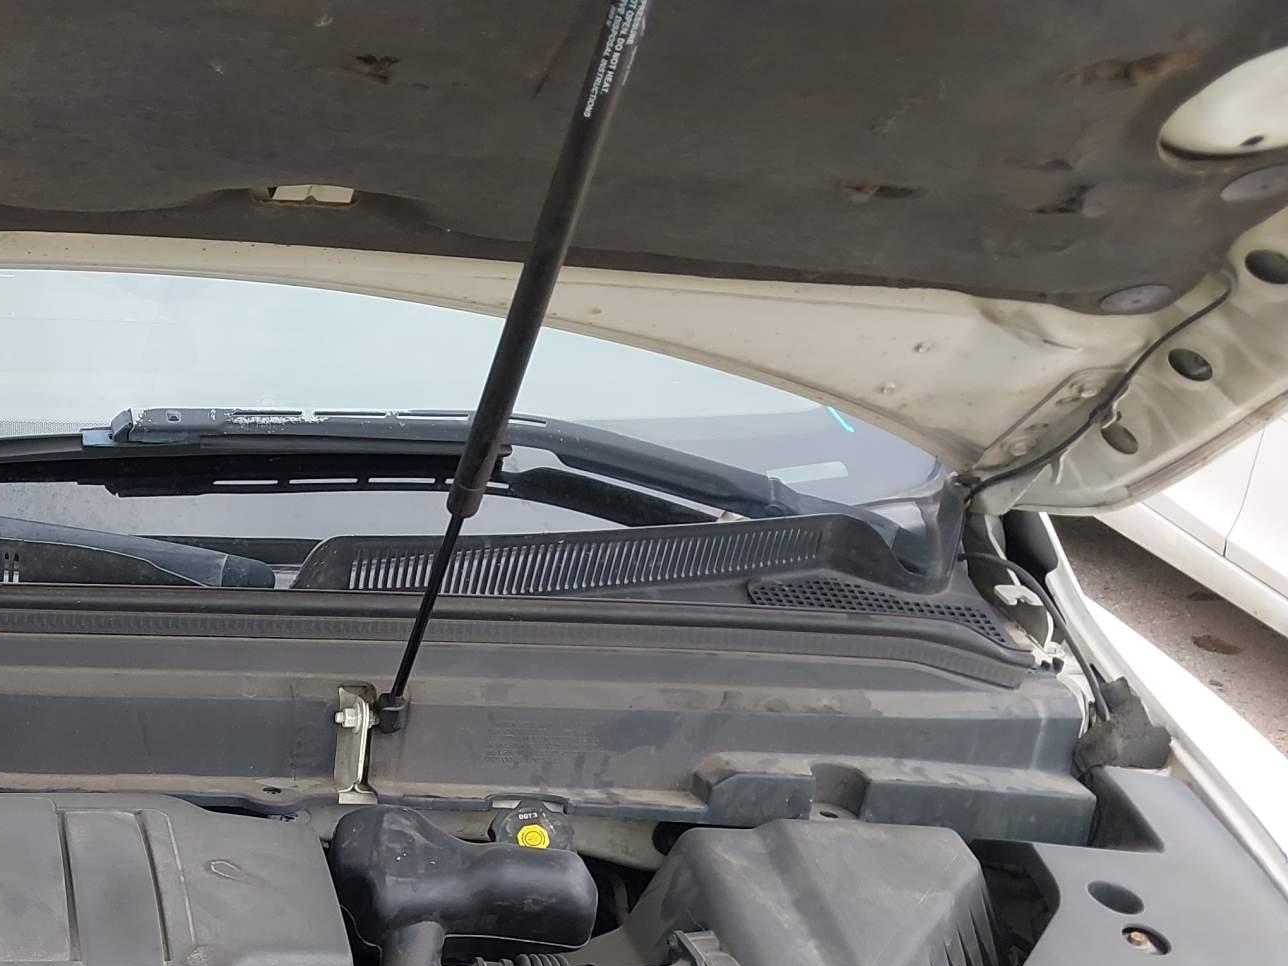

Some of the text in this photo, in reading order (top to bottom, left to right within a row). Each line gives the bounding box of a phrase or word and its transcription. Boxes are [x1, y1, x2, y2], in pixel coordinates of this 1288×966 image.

[602, 15, 622, 57] DISPOSAL
[614, 38, 625, 51] DO
[608, 52, 620, 70] NOT
[583, 58, 607, 117] INSTRUCTIONS
